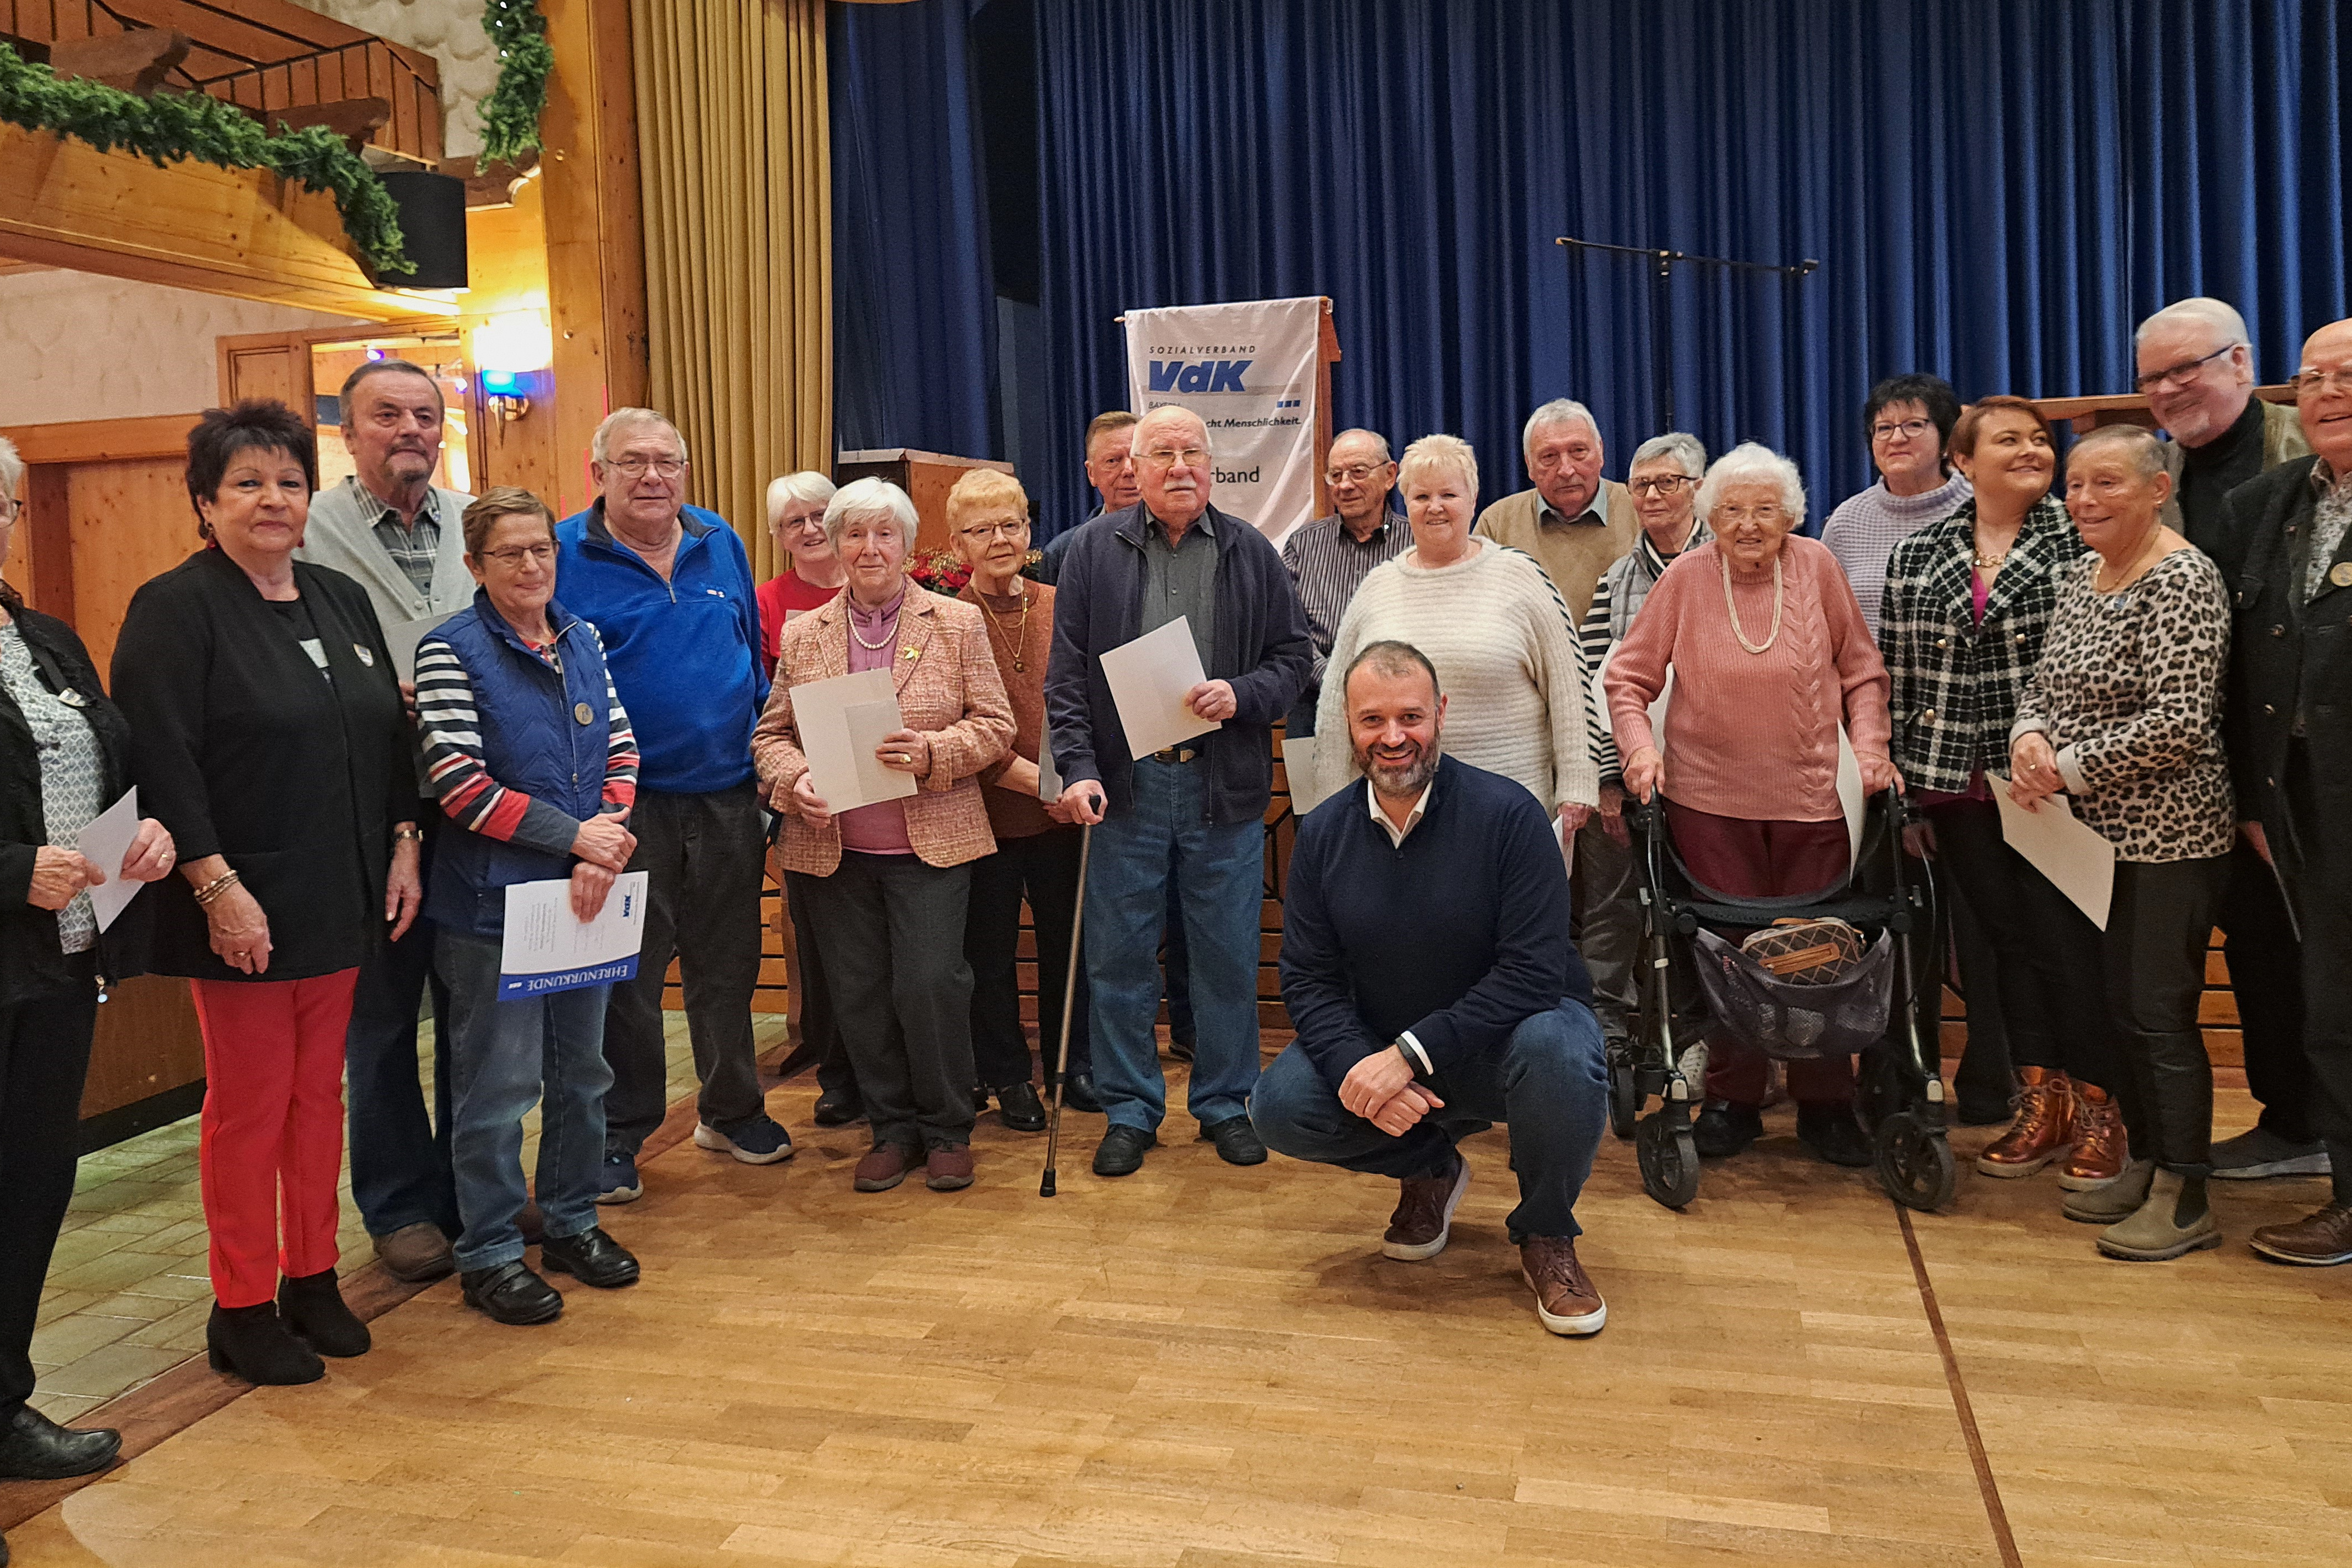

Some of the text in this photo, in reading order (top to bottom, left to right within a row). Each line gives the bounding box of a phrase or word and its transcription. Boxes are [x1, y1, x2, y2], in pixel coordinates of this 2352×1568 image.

[1149, 345, 1255, 354] SOZIALVERBAND
[1149, 360, 1254, 393] VdK
[527, 964, 628, 991] EHRENURKUNDE
